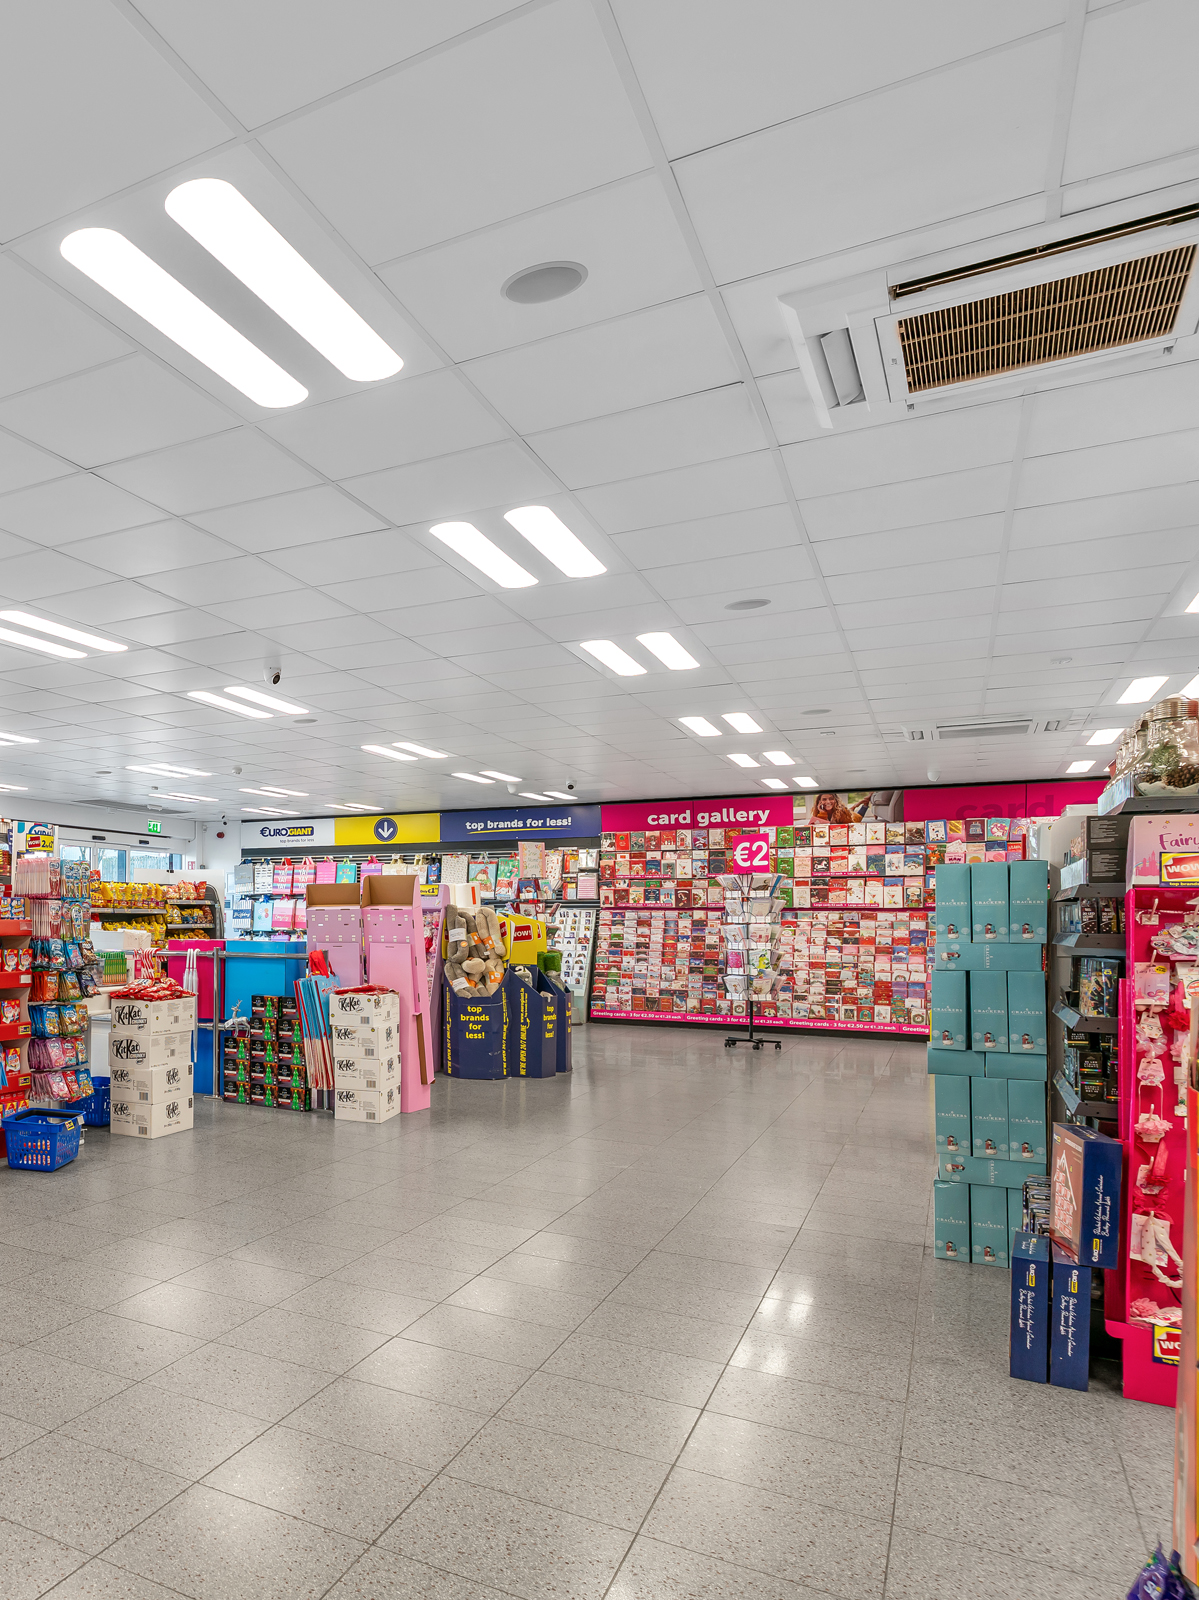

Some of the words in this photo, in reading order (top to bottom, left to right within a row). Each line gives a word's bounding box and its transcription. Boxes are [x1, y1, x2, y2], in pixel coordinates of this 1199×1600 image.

[466, 821, 484, 830] top
[487, 820, 523, 829] brands
[526, 818, 543, 827] for
[546, 817, 572, 827] less!
[647, 809, 691, 825] card
[697, 808, 770, 827] gallery
[733, 841, 769, 867] €2
[117, 1004, 141, 1026] KitKat
[467, 1005, 482, 1014] top
[115, 1039, 140, 1059] KitKat
